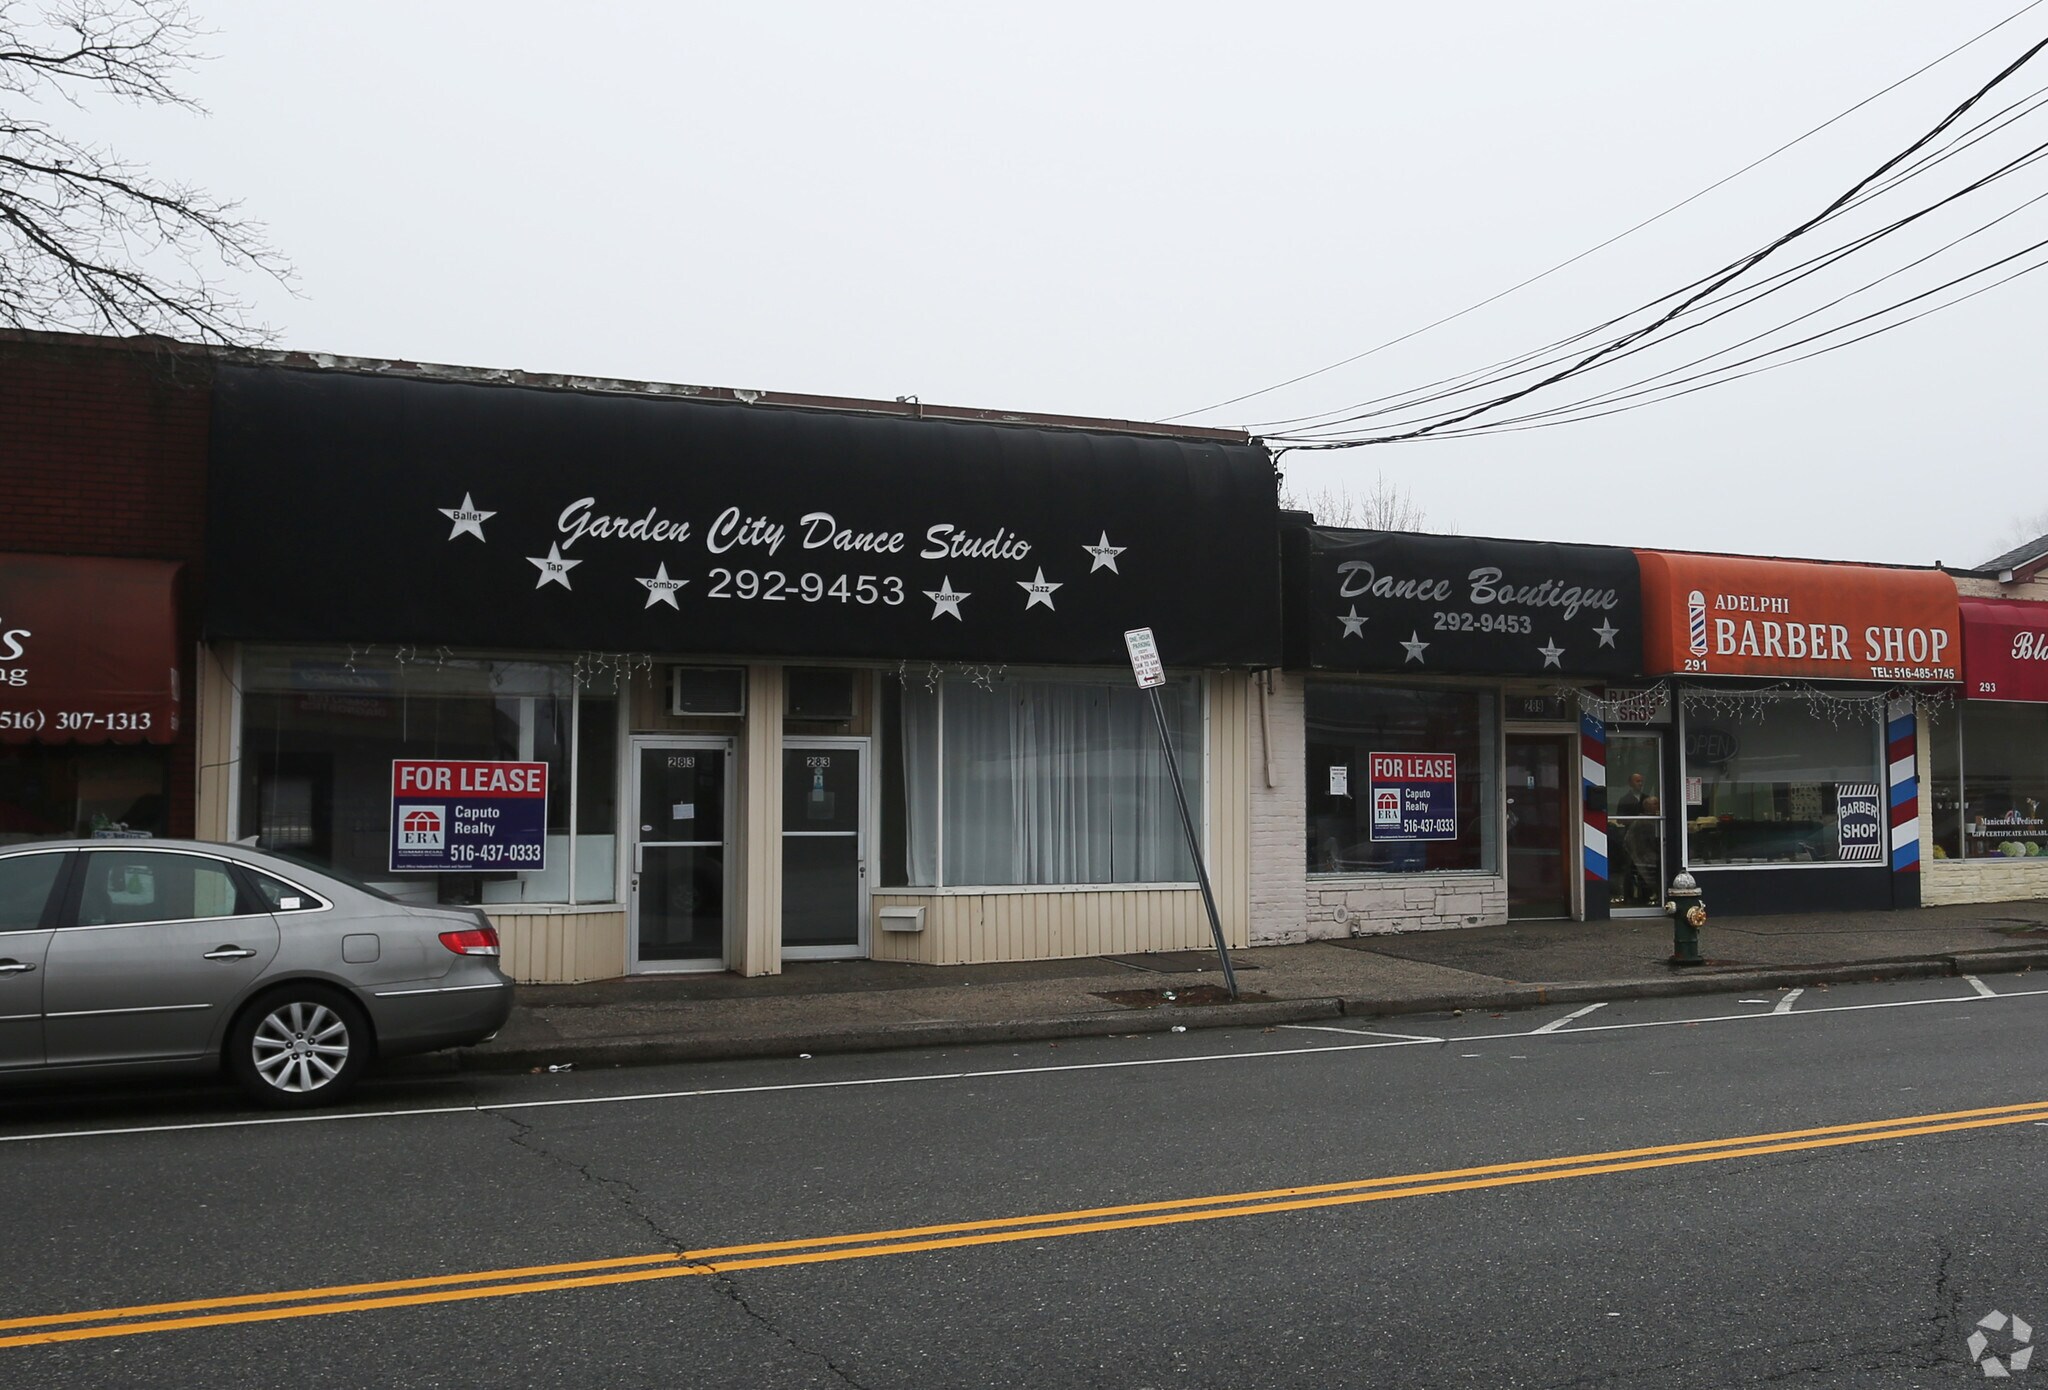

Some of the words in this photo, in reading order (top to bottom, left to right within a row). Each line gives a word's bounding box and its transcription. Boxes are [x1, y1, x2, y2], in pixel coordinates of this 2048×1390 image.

[453, 511, 482, 522] Ballet
[558, 497, 690, 550] Garden
[706, 506, 785, 556] City
[800, 512, 904, 553] Dance
[920, 524, 1031, 561] Studio
[1091, 547, 1118, 555] Hip-Hop
[546, 562, 563, 573] Tap
[646, 579, 678, 590] Combo
[708, 568, 905, 606] 292-9453
[1030, 584, 1050, 594] Jazz
[1337, 560, 1452, 600] Dance
[1468, 567, 1618, 621] Boutique
[934, 592, 960, 602] Pointe
[1714, 594, 1790, 614] ADELPHI
[1433, 612, 1532, 634] 292-9453
[1132, 641, 1151, 649] PARKING
[1715, 618, 1852, 661] BARBER
[1865, 626, 1949, 664] SHOP
[1684, 659, 1707, 672] 291
[1871, 667, 1893, 679] TEL:
[1894, 668, 1955, 681] 516-485-1745
[1980, 682, 1996, 693] 293
[1525, 700, 1543, 712] 289
[1619, 707, 1656, 720] SHOP
[56, 712, 151, 731] 307-1313
[668, 757, 695, 768] 283
[807, 757, 830, 767] 283
[1375, 758, 1403, 777] FOR
[1407, 758, 1452, 778] LEASE
[401, 767, 451, 791] FOR
[460, 768, 541, 792] LEASE
[1405, 788, 1431, 800] Caputo
[455, 805, 500, 821] Caputo
[1405, 800, 1429, 813] Realty
[1840, 801, 1878, 818] BARBER
[1378, 810, 1398, 820] ERA
[1981, 817, 2010, 826] Manicure
[2017, 817, 2044, 825] Pedicure
[454, 822, 496, 836] Realty
[1404, 819, 1454, 834] 516-437-0333
[1842, 824, 1877, 839] SHOP
[405, 833, 439, 843] ERA
[450, 844, 541, 862] 516-437-0333
